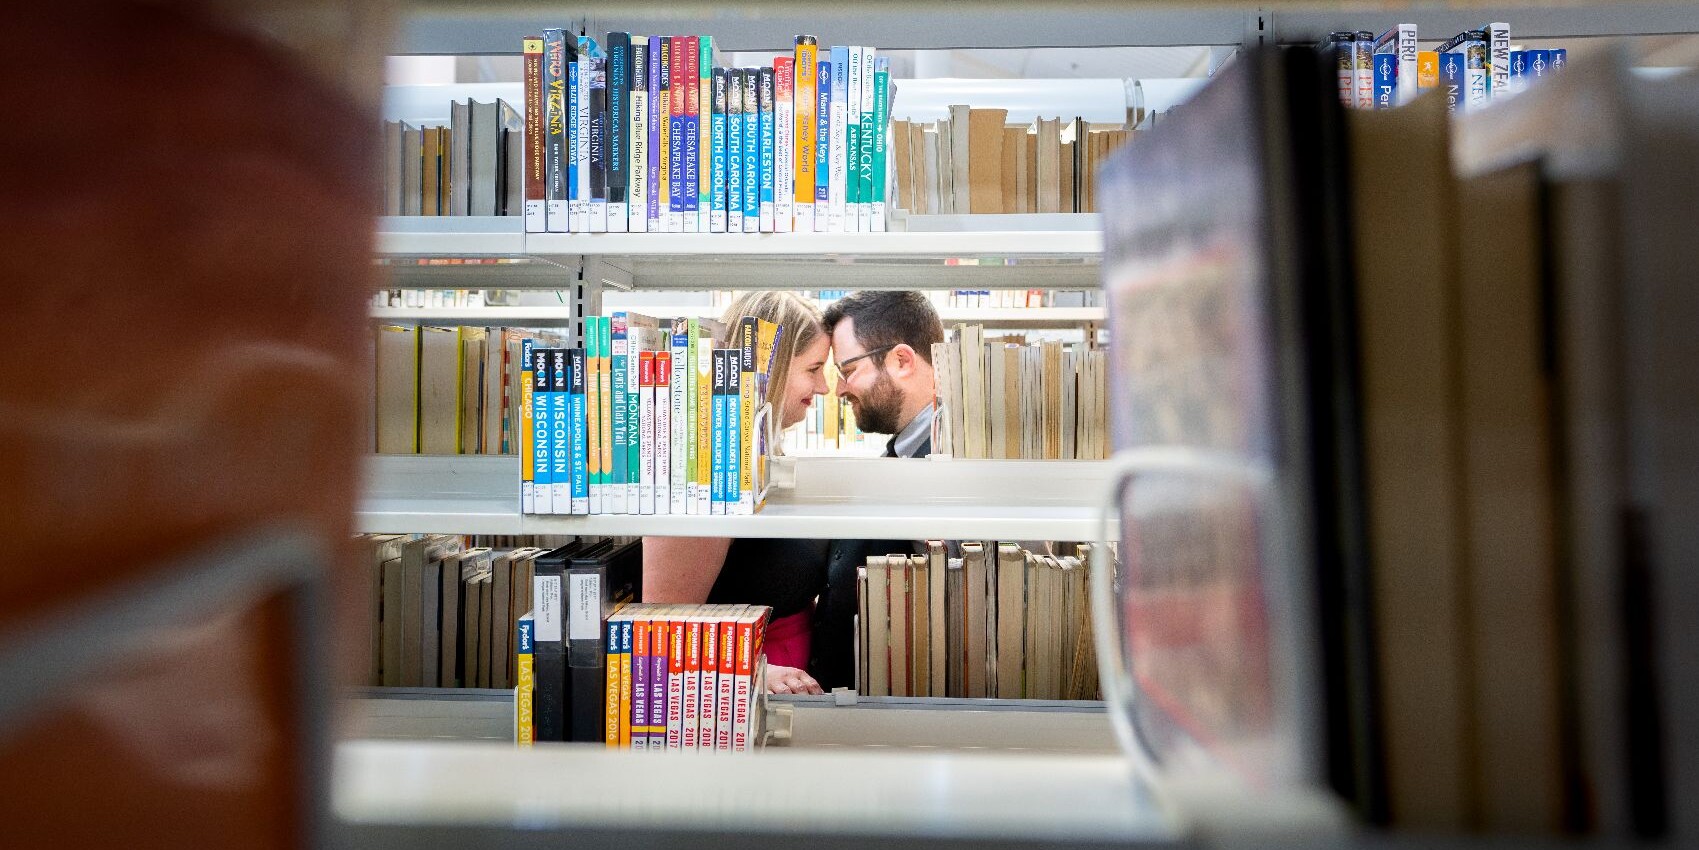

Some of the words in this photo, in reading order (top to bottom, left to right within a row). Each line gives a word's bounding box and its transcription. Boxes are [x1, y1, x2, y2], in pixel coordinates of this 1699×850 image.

[672, 41, 681, 72] BACKROADS
[688, 41, 696, 72] BACKROADS
[1402, 30, 1416, 62] PERU
[1493, 29, 1509, 61] NEW
[732, 76, 741, 105] MOON
[747, 75, 756, 105] MOON
[762, 73, 771, 104] MOON
[777, 65, 785, 91] Guide
[1338, 76, 1352, 108] PER
[1359, 76, 1372, 108] PER
[634, 95, 642, 122] Hiking
[820, 92, 828, 117] Miami
[1380, 85, 1392, 109] Per
[579, 107, 589, 162] VIRGINIA
[591, 118, 599, 163] VIRGINIA
[714, 117, 724, 153] NORTH
[730, 117, 740, 153] SOUTH
[746, 115, 757, 152] SOUTH
[801, 112, 810, 142] Disney
[819, 127, 828, 142] the
[634, 141, 642, 163] Ridge
[672, 121, 681, 180] CHESAPEAKE
[686, 121, 696, 180] CHESAPEAKE
[762, 114, 771, 189] CHARLESTON
[802, 146, 810, 173] World
[818, 143, 827, 163] Keys
[849, 126, 857, 171] ARKANSAS
[860, 112, 873, 182] KENTUCKY
[634, 165, 642, 197] Parkway
[672, 182, 681, 198] BAY
[686, 182, 696, 198] BAY
[714, 155, 724, 210] CAROLINA
[730, 155, 741, 210] CAROLINA
[746, 156, 758, 211] CAROLINA
[524, 342, 532, 368] Fodor's
[537, 352, 546, 387] MOON
[554, 352, 564, 387] MOON
[614, 368, 626, 389] Lewis
[673, 349, 684, 415] Yellowstone
[716, 357, 724, 387] MOON
[730, 356, 738, 388] MOON
[524, 378, 532, 419] CHICAGO
[614, 390, 626, 404] and
[574, 397, 582, 451] MINNEAPOLIS
[614, 405, 626, 425] Clark
[628, 394, 638, 446] MONTANA
[728, 398, 736, 429] DENVER,
[536, 395, 548, 473] WISCONSIN
[554, 395, 565, 473] WISCONSIN
[614, 426, 626, 445] Trail
[728, 430, 736, 463] BOULDER
[574, 461, 582, 472] ST.
[575, 474, 583, 495] PAUL
[610, 624, 618, 651] Fodor's
[622, 624, 630, 650] Fodor's
[691, 623, 699, 666] FROMMER'S
[742, 628, 750, 670] FROMMER'S
[521, 661, 531, 682] LAS
[608, 660, 617, 680] LAS
[687, 676, 695, 690] LAS
[704, 676, 712, 690] LAS
[608, 681, 617, 715] VEGAS
[636, 683, 645, 698] LAS
[653, 683, 663, 698] LAS
[671, 678, 680, 693] LAS
[721, 679, 730, 693] LAS
[738, 680, 746, 695] LAS
[521, 683, 531, 723] VEGAS
[635, 700, 645, 724] VEGAS
[653, 700, 663, 724] VEGAS
[670, 696, 679, 721] VEGAS
[686, 693, 695, 719] VEGAS
[703, 693, 712, 719] VEGAS
[720, 696, 729, 722] VEGAS
[737, 698, 746, 723] VEGAS
[608, 717, 617, 740] 2016
[669, 730, 678, 749] 2017
[685, 727, 694, 747] 2018
[702, 727, 711, 747] 2018
[736, 732, 745, 751] 2019
